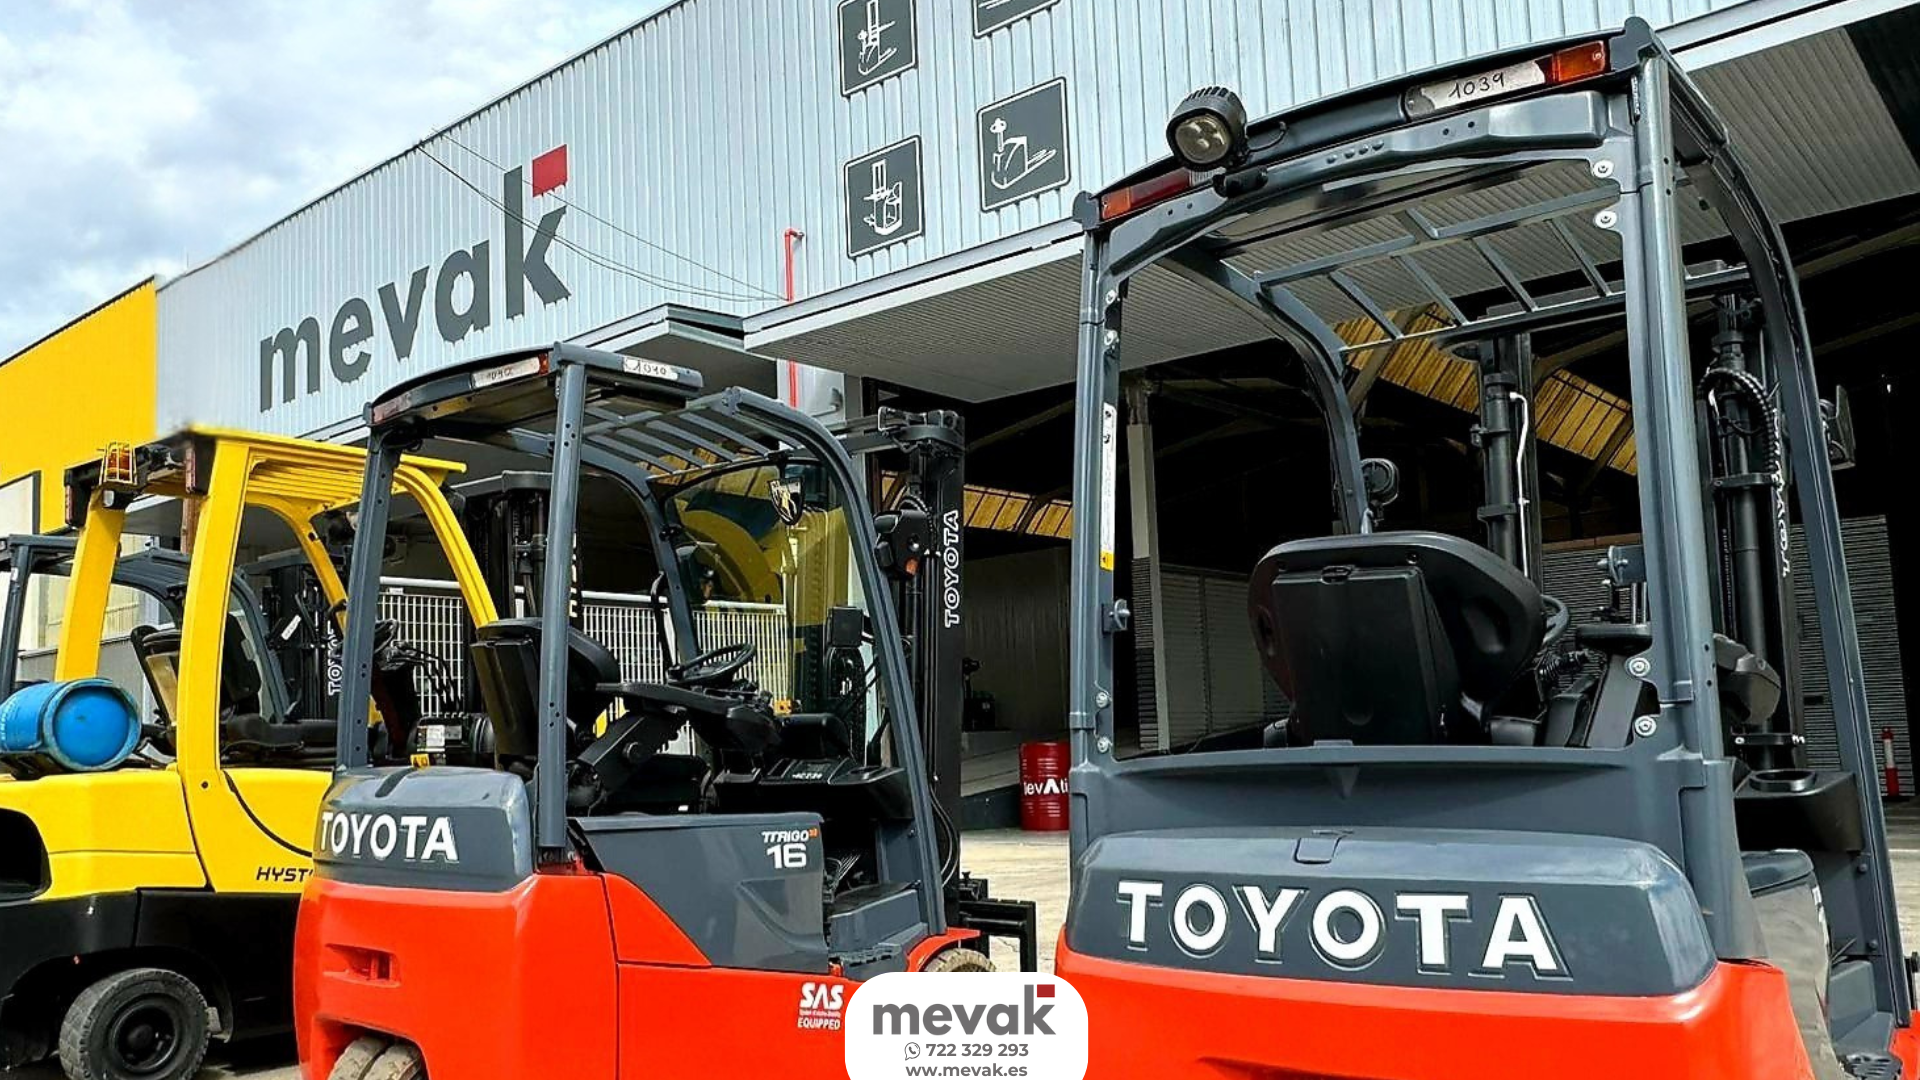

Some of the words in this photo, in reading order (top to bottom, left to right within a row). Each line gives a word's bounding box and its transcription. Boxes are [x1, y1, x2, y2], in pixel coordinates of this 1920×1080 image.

[1449, 72, 1506, 99] 1039
[260, 164, 572, 413] mevak
[943, 509, 960, 629] TOYOTA
[321, 811, 459, 862] TOYOTA
[766, 843, 807, 869] 16
[256, 866, 314, 883] HYST
[1117, 881, 1567, 976] TOYOTA
[799, 981, 844, 1010] SAS
[797, 1016, 841, 1030] EQUIPPED
